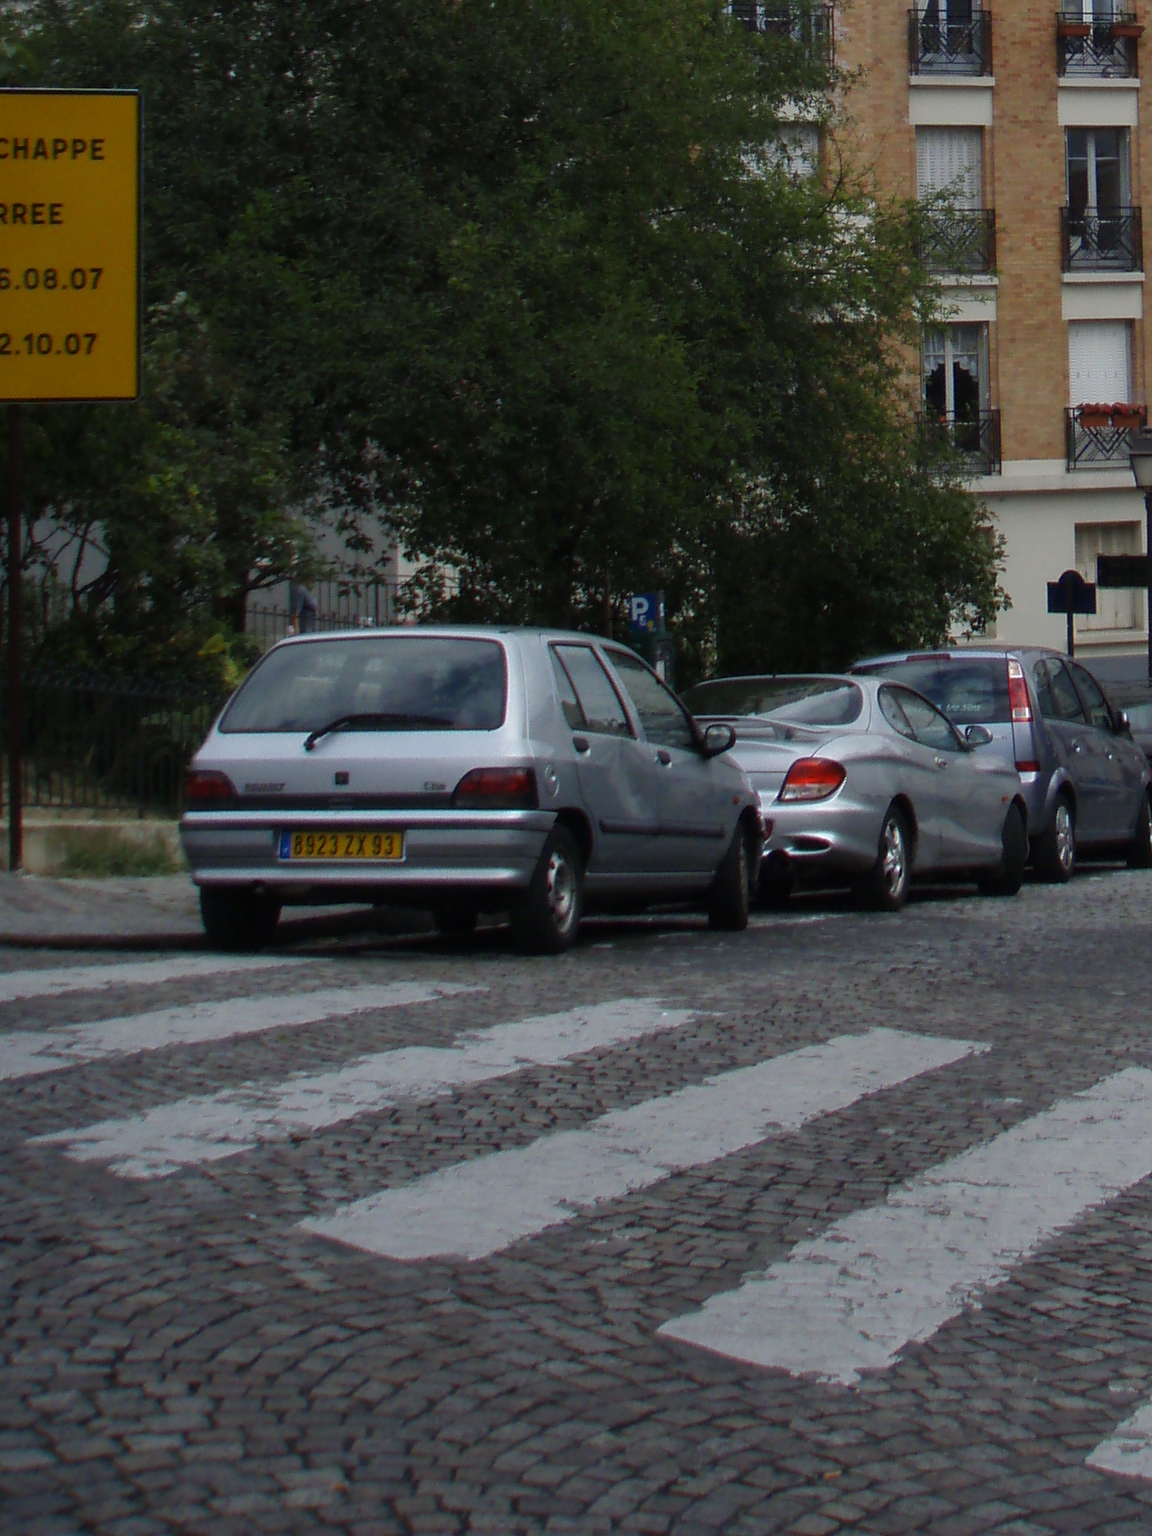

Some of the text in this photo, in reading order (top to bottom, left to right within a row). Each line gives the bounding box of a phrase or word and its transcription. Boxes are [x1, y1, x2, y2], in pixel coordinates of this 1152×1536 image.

[631, 596, 649, 621] P
[293, 834, 394, 856] 8923 ZX 93
